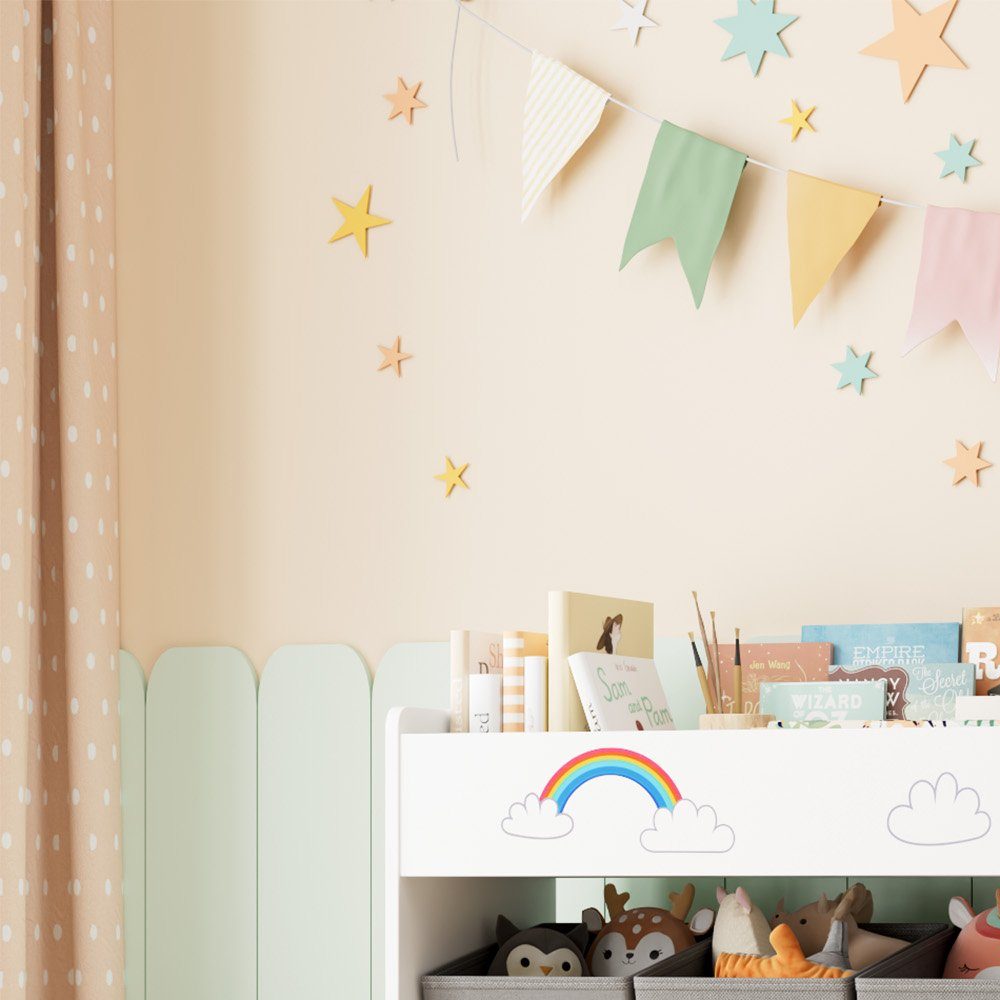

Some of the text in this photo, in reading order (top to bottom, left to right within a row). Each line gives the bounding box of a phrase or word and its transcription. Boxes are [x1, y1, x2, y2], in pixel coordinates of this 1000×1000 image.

[852, 644, 926, 660] EMPIRE
[749, 660, 765, 670] Jen
[912, 666, 932, 681] The
[596, 666, 632, 703] Sam
[918, 668, 968, 696] Secret
[791, 694, 863, 710] WIZARD
[640, 695, 674, 729] Pam
